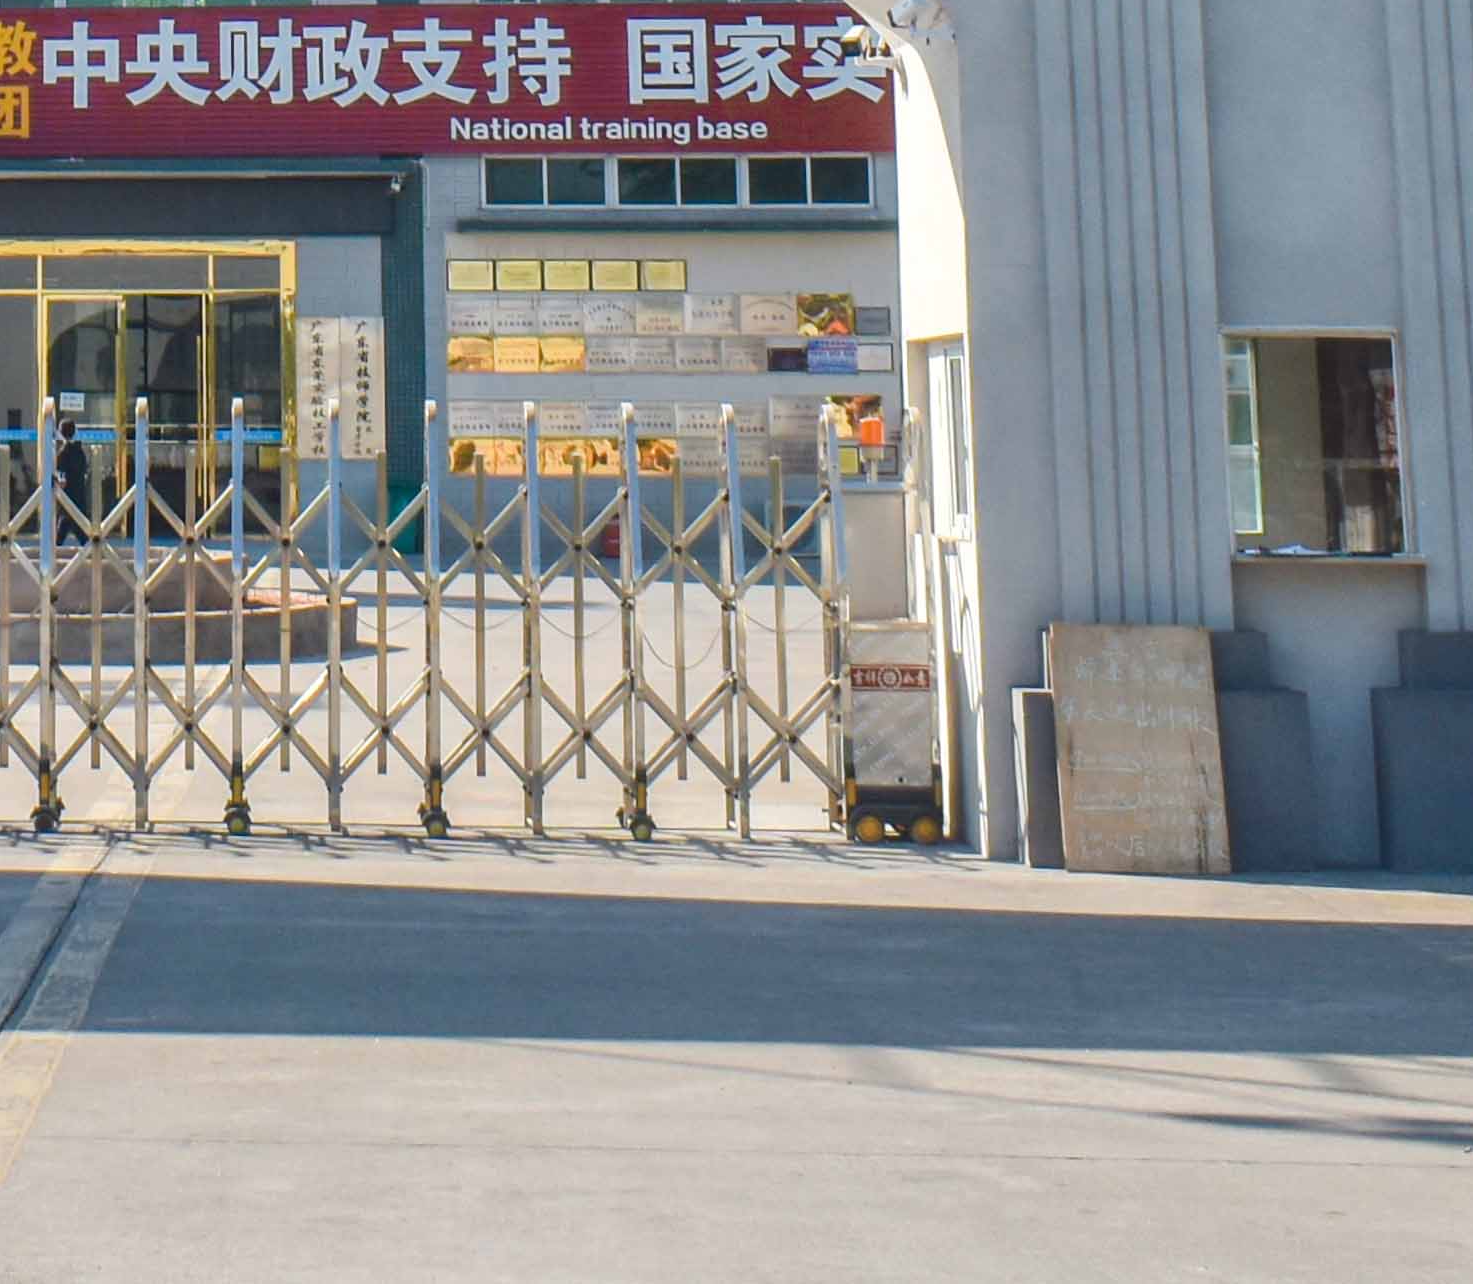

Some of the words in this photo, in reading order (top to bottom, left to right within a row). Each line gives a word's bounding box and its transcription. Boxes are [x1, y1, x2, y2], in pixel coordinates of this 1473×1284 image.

[41, 16, 572, 109] 中央财政支持
[450, 115, 573, 142] National
[579, 115, 691, 146] training
[698, 115, 769, 142] base
